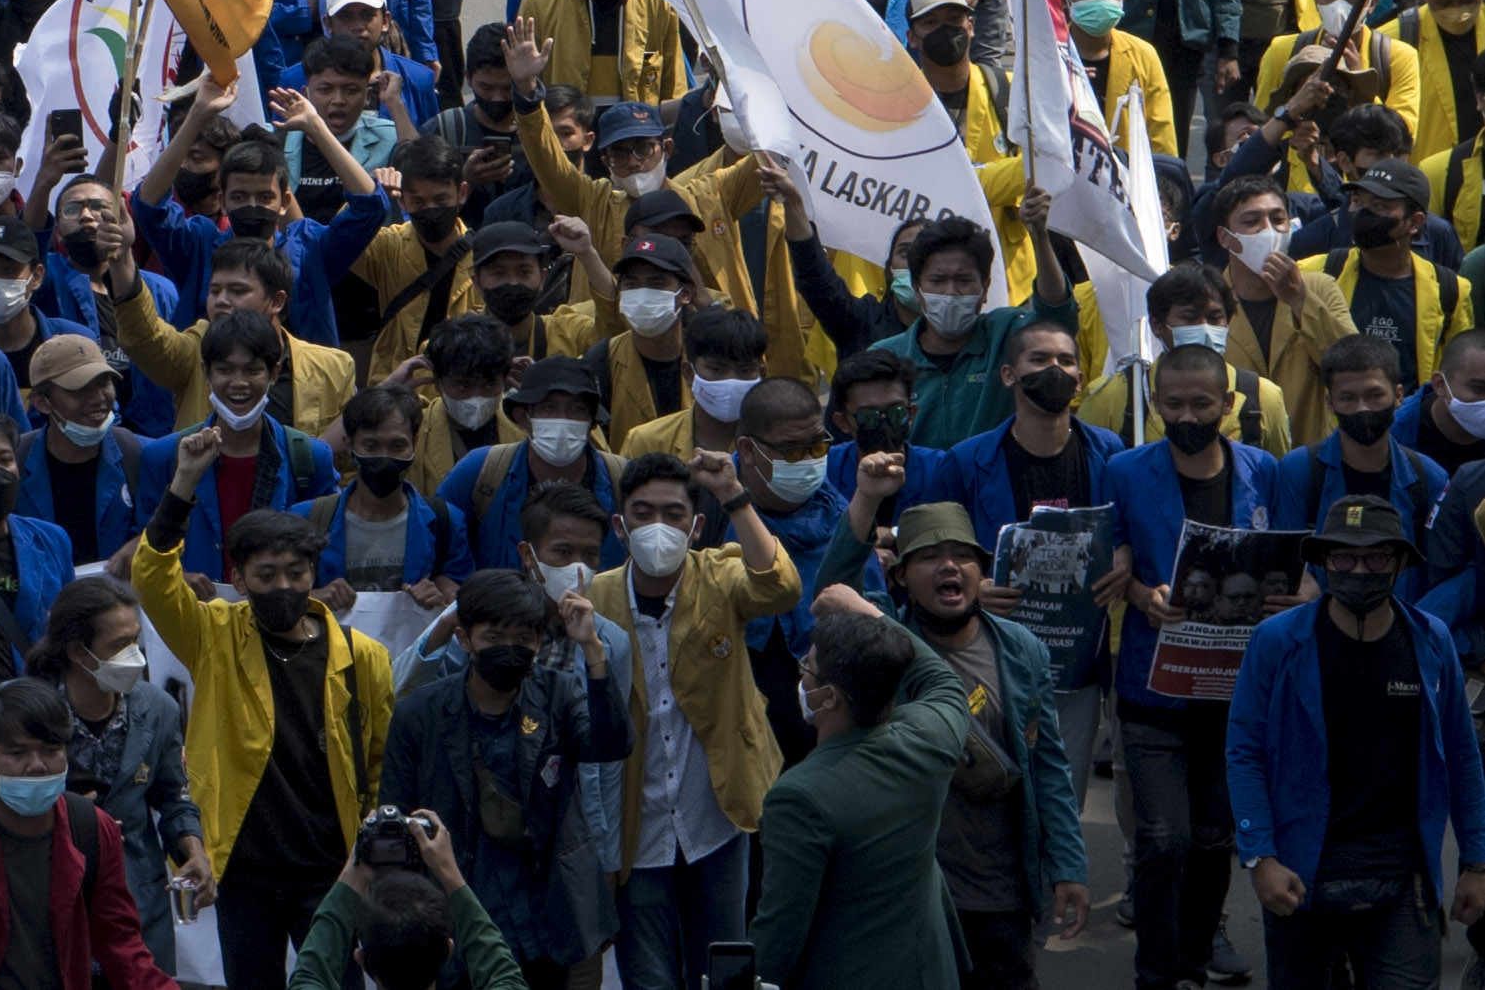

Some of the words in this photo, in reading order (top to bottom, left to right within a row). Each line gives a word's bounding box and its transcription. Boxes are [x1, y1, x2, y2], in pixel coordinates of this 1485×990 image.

[1366, 327, 1399, 339] TAKES
[1181, 623, 1224, 635] JANGAN
[1164, 634, 1211, 647] PEGAWAI
